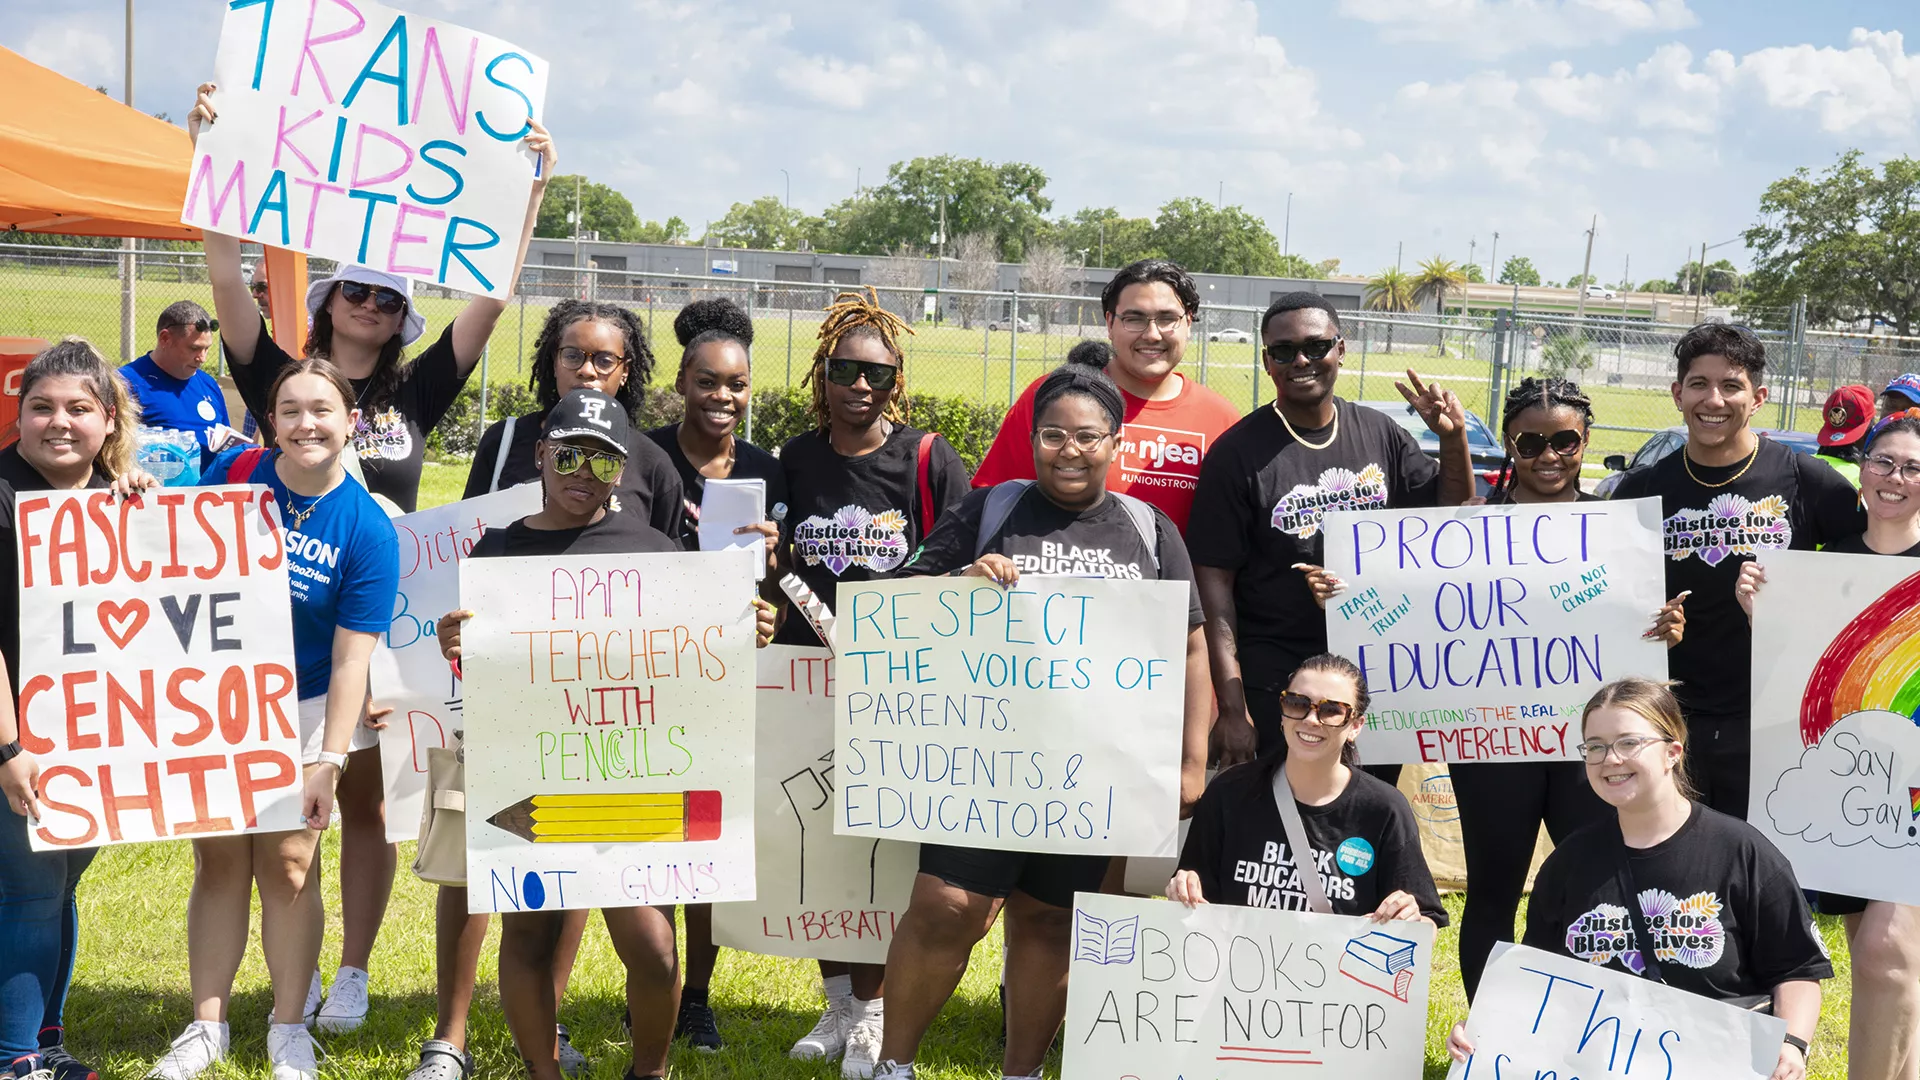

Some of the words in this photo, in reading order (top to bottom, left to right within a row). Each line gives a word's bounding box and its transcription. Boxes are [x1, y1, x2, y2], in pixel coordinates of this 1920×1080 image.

[229, 0, 534, 142] TRANS
[270, 105, 468, 206] KIDS
[185, 154, 501, 292] MATTER
[1138, 433, 1199, 468] njea
[1120, 473, 1198, 490] #UNIONSTRON
[1285, 488, 1351, 512] Justice
[1353, 482, 1380, 499] for
[18, 487, 284, 589] FASCISTS
[798, 523, 860, 541] Justice
[864, 523, 895, 541] for
[1281, 506, 1327, 531] Blac
[1663, 531, 1720, 551] Black
[1724, 528, 1784, 546] Lives
[1665, 513, 1741, 535] Justice
[1746, 511, 1777, 528] for
[284, 527, 340, 569] SION
[845, 540, 899, 558] Lives
[1041, 540, 1114, 564] BLACK
[1352, 512, 1608, 576] PROTECT
[1011, 553, 1143, 580] EDUCATORS
[1549, 581, 1571, 600] DO
[1580, 564, 1607, 585] NOT
[551, 567, 643, 621] ARM
[1336, 587, 1379, 621] TEACH
[1360, 598, 1388, 621] THE
[1368, 593, 1415, 636] TRUTH!
[1434, 576, 1529, 633] OUR
[1562, 579, 1610, 613] CENSOR!
[852, 590, 1095, 646] RESPECT
[510, 625, 726, 684] TEACHERS
[845, 647, 937, 686] THE
[961, 649, 1092, 691] VOICES
[1115, 656, 1169, 691] OF
[1358, 634, 1603, 695] EDUCATION
[19, 663, 297, 755] CENSOR
[564, 685, 656, 726] WITH
[536, 725, 693, 782] PENCILS
[1416, 722, 1569, 763] EMERGENCY
[1830, 731, 1894, 795] Say
[1062, 753, 1083, 790] &
[34, 750, 297, 846] SHIP
[845, 784, 1114, 840] EDUCATORS!
[490, 866, 577, 912] NOT
[620, 862, 722, 904] GUNS
[1234, 860, 1355, 901] EDUCAORS
[1671, 909, 1708, 929] for
[1141, 927, 1327, 993] BOOKS
[1084, 990, 1199, 1045] ARE
[1224, 996, 1314, 1043] NOT
[1321, 1002, 1388, 1051] FOR
[1519, 966, 1681, 1080] This
